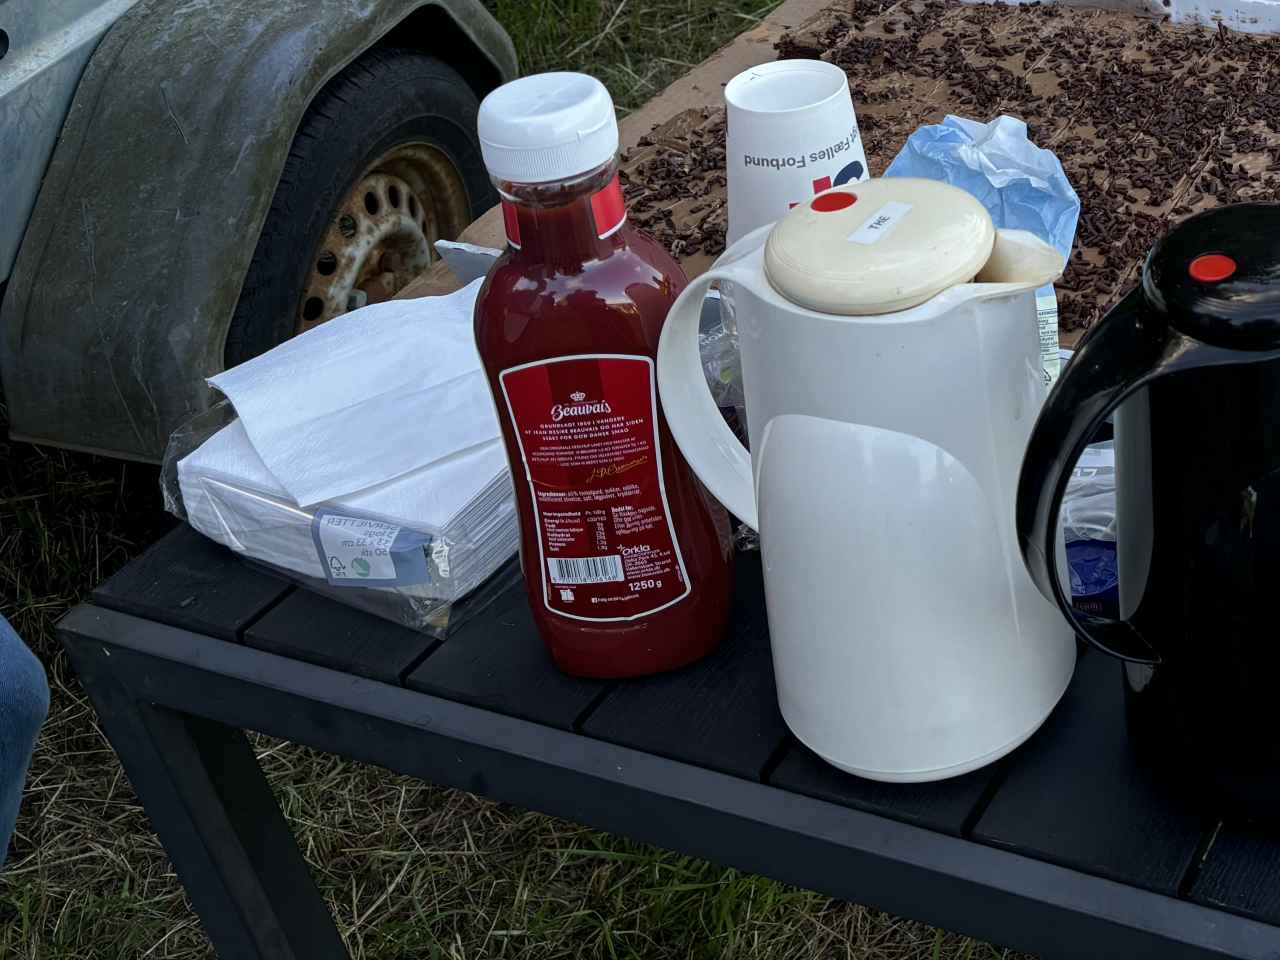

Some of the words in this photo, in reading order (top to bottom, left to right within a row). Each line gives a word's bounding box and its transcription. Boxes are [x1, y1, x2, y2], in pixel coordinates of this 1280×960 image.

[809, 137, 850, 162] Fælles
[744, 154, 807, 170] Forbund
[867, 215, 890, 230] THE
[550, 400, 612, 422] Beauvais
[622, 544, 650, 556] orkla
[629, 580, 655, 591] 1250
[656, 580, 663, 588] g
